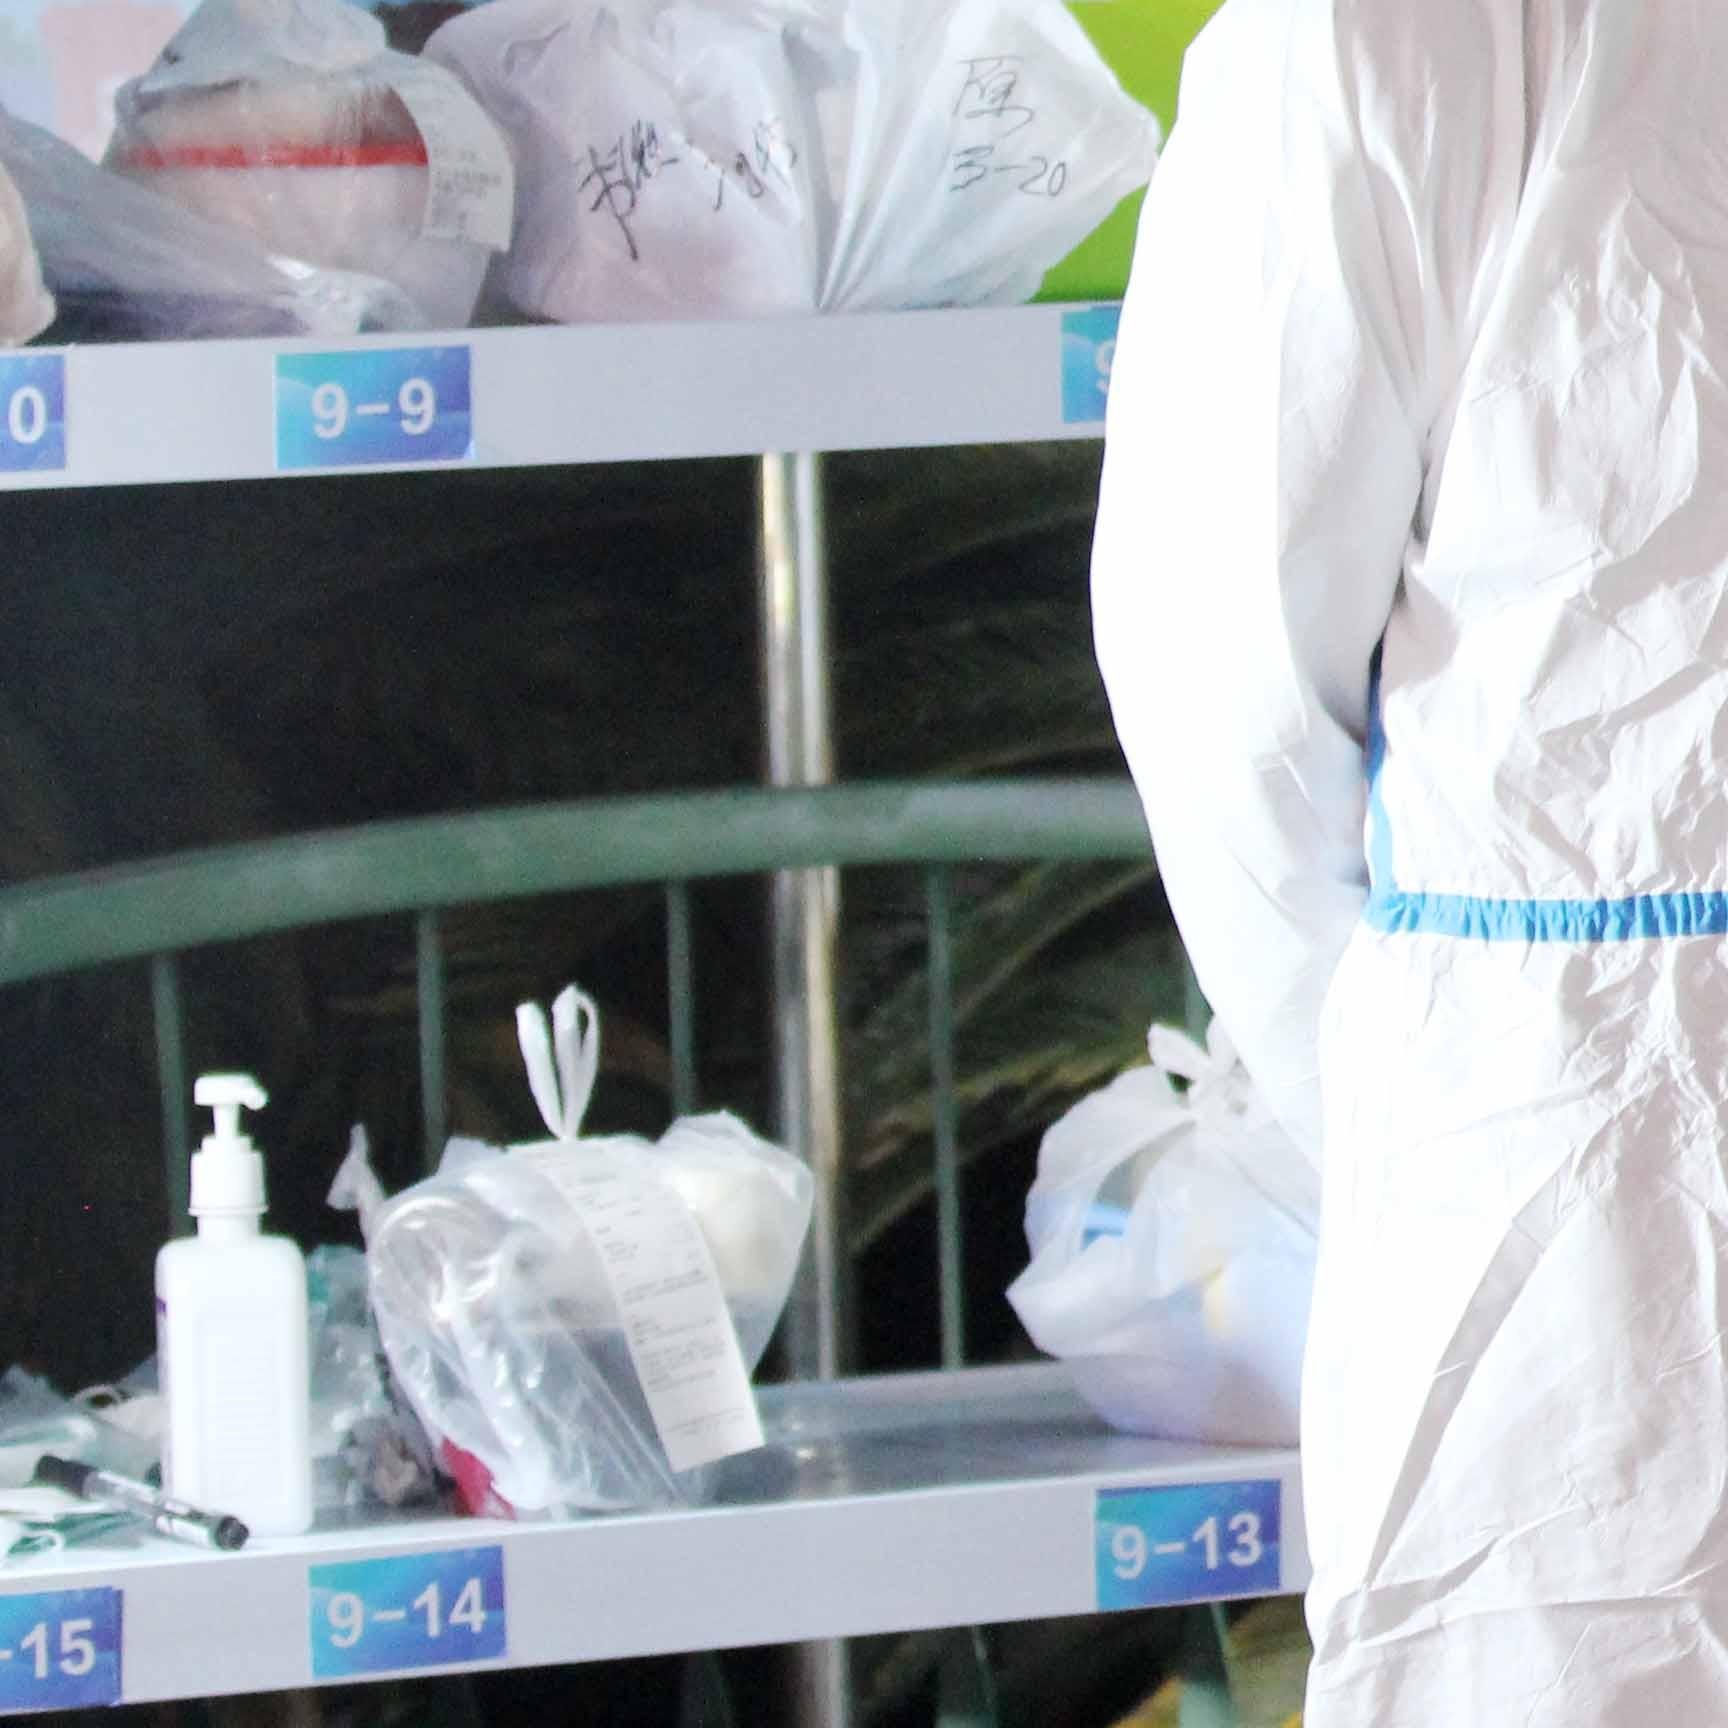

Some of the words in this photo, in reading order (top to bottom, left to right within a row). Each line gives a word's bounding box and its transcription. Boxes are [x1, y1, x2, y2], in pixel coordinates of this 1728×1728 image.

[310, 377, 437, 440] 9-9
[1110, 1511, 1265, 1581] 9-13
[326, 1576, 488, 1649] 9-14
